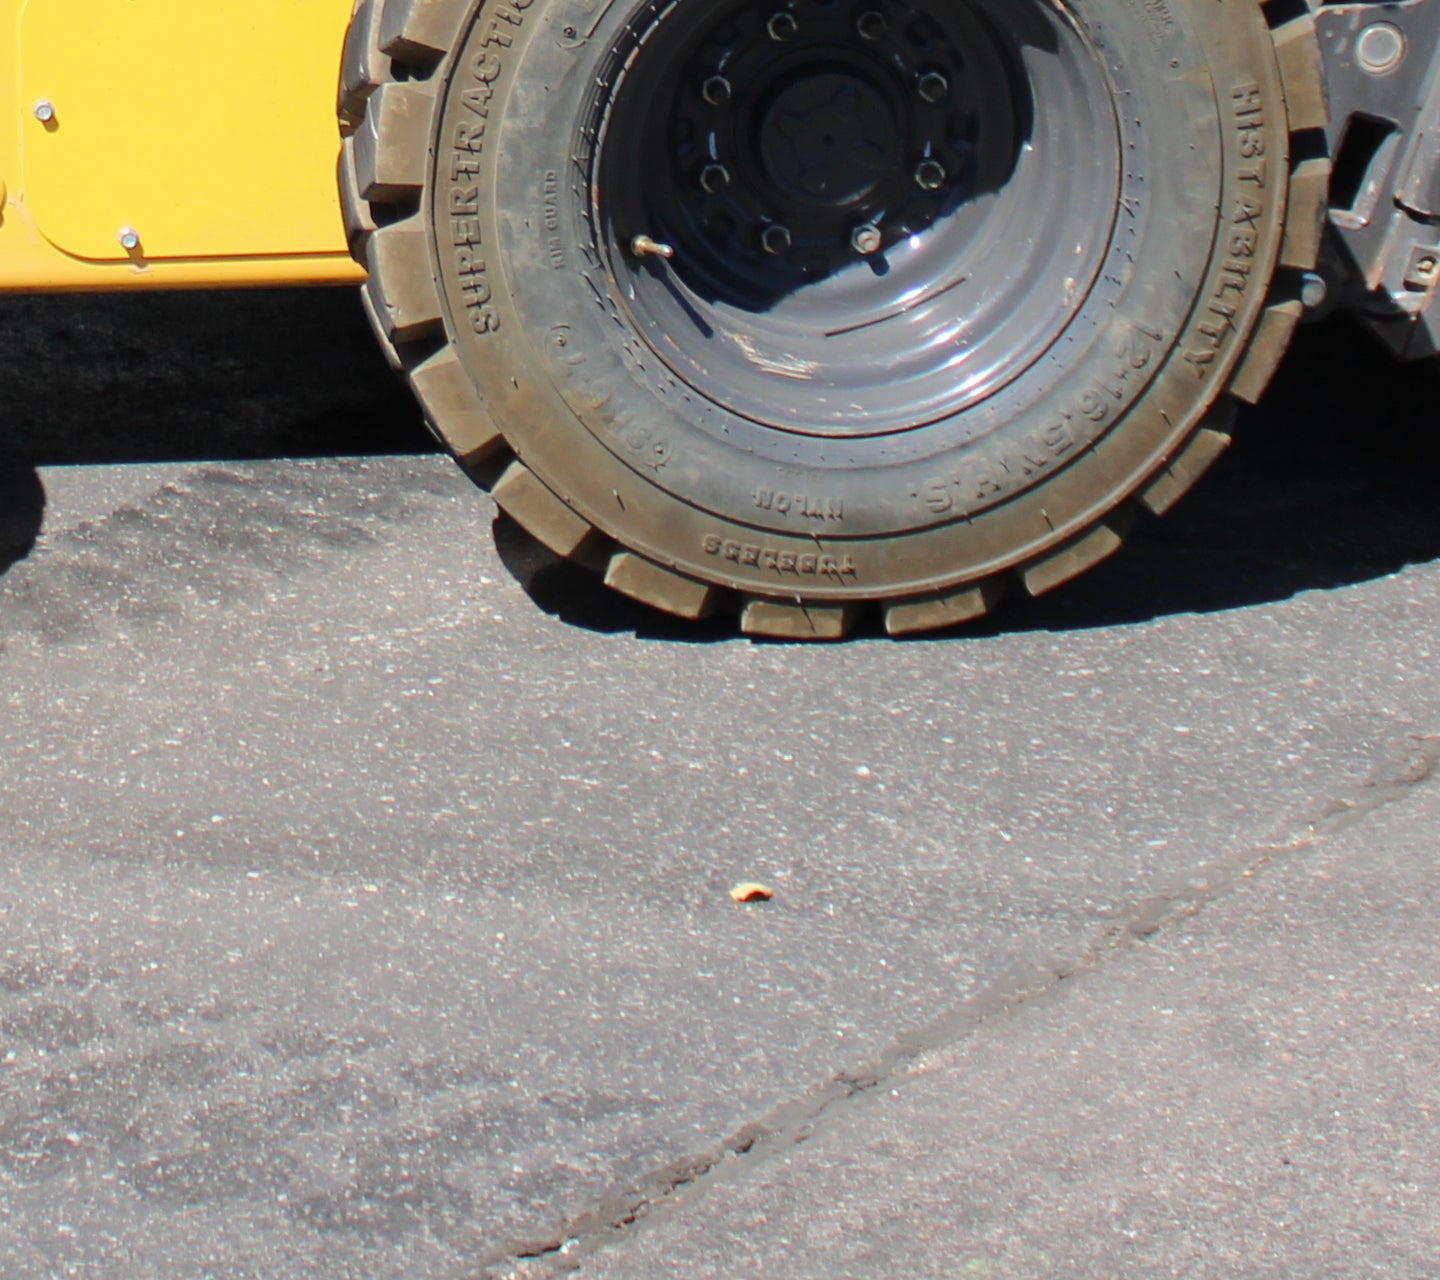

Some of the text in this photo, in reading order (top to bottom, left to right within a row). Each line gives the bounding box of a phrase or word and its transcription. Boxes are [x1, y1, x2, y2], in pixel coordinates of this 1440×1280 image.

[542, 168, 558, 233] GUARD
[1182, 82, 1267, 379] HISTABILITY
[752, 489, 844, 522] NYLON
[702, 534, 857, 579] TUBELESS
